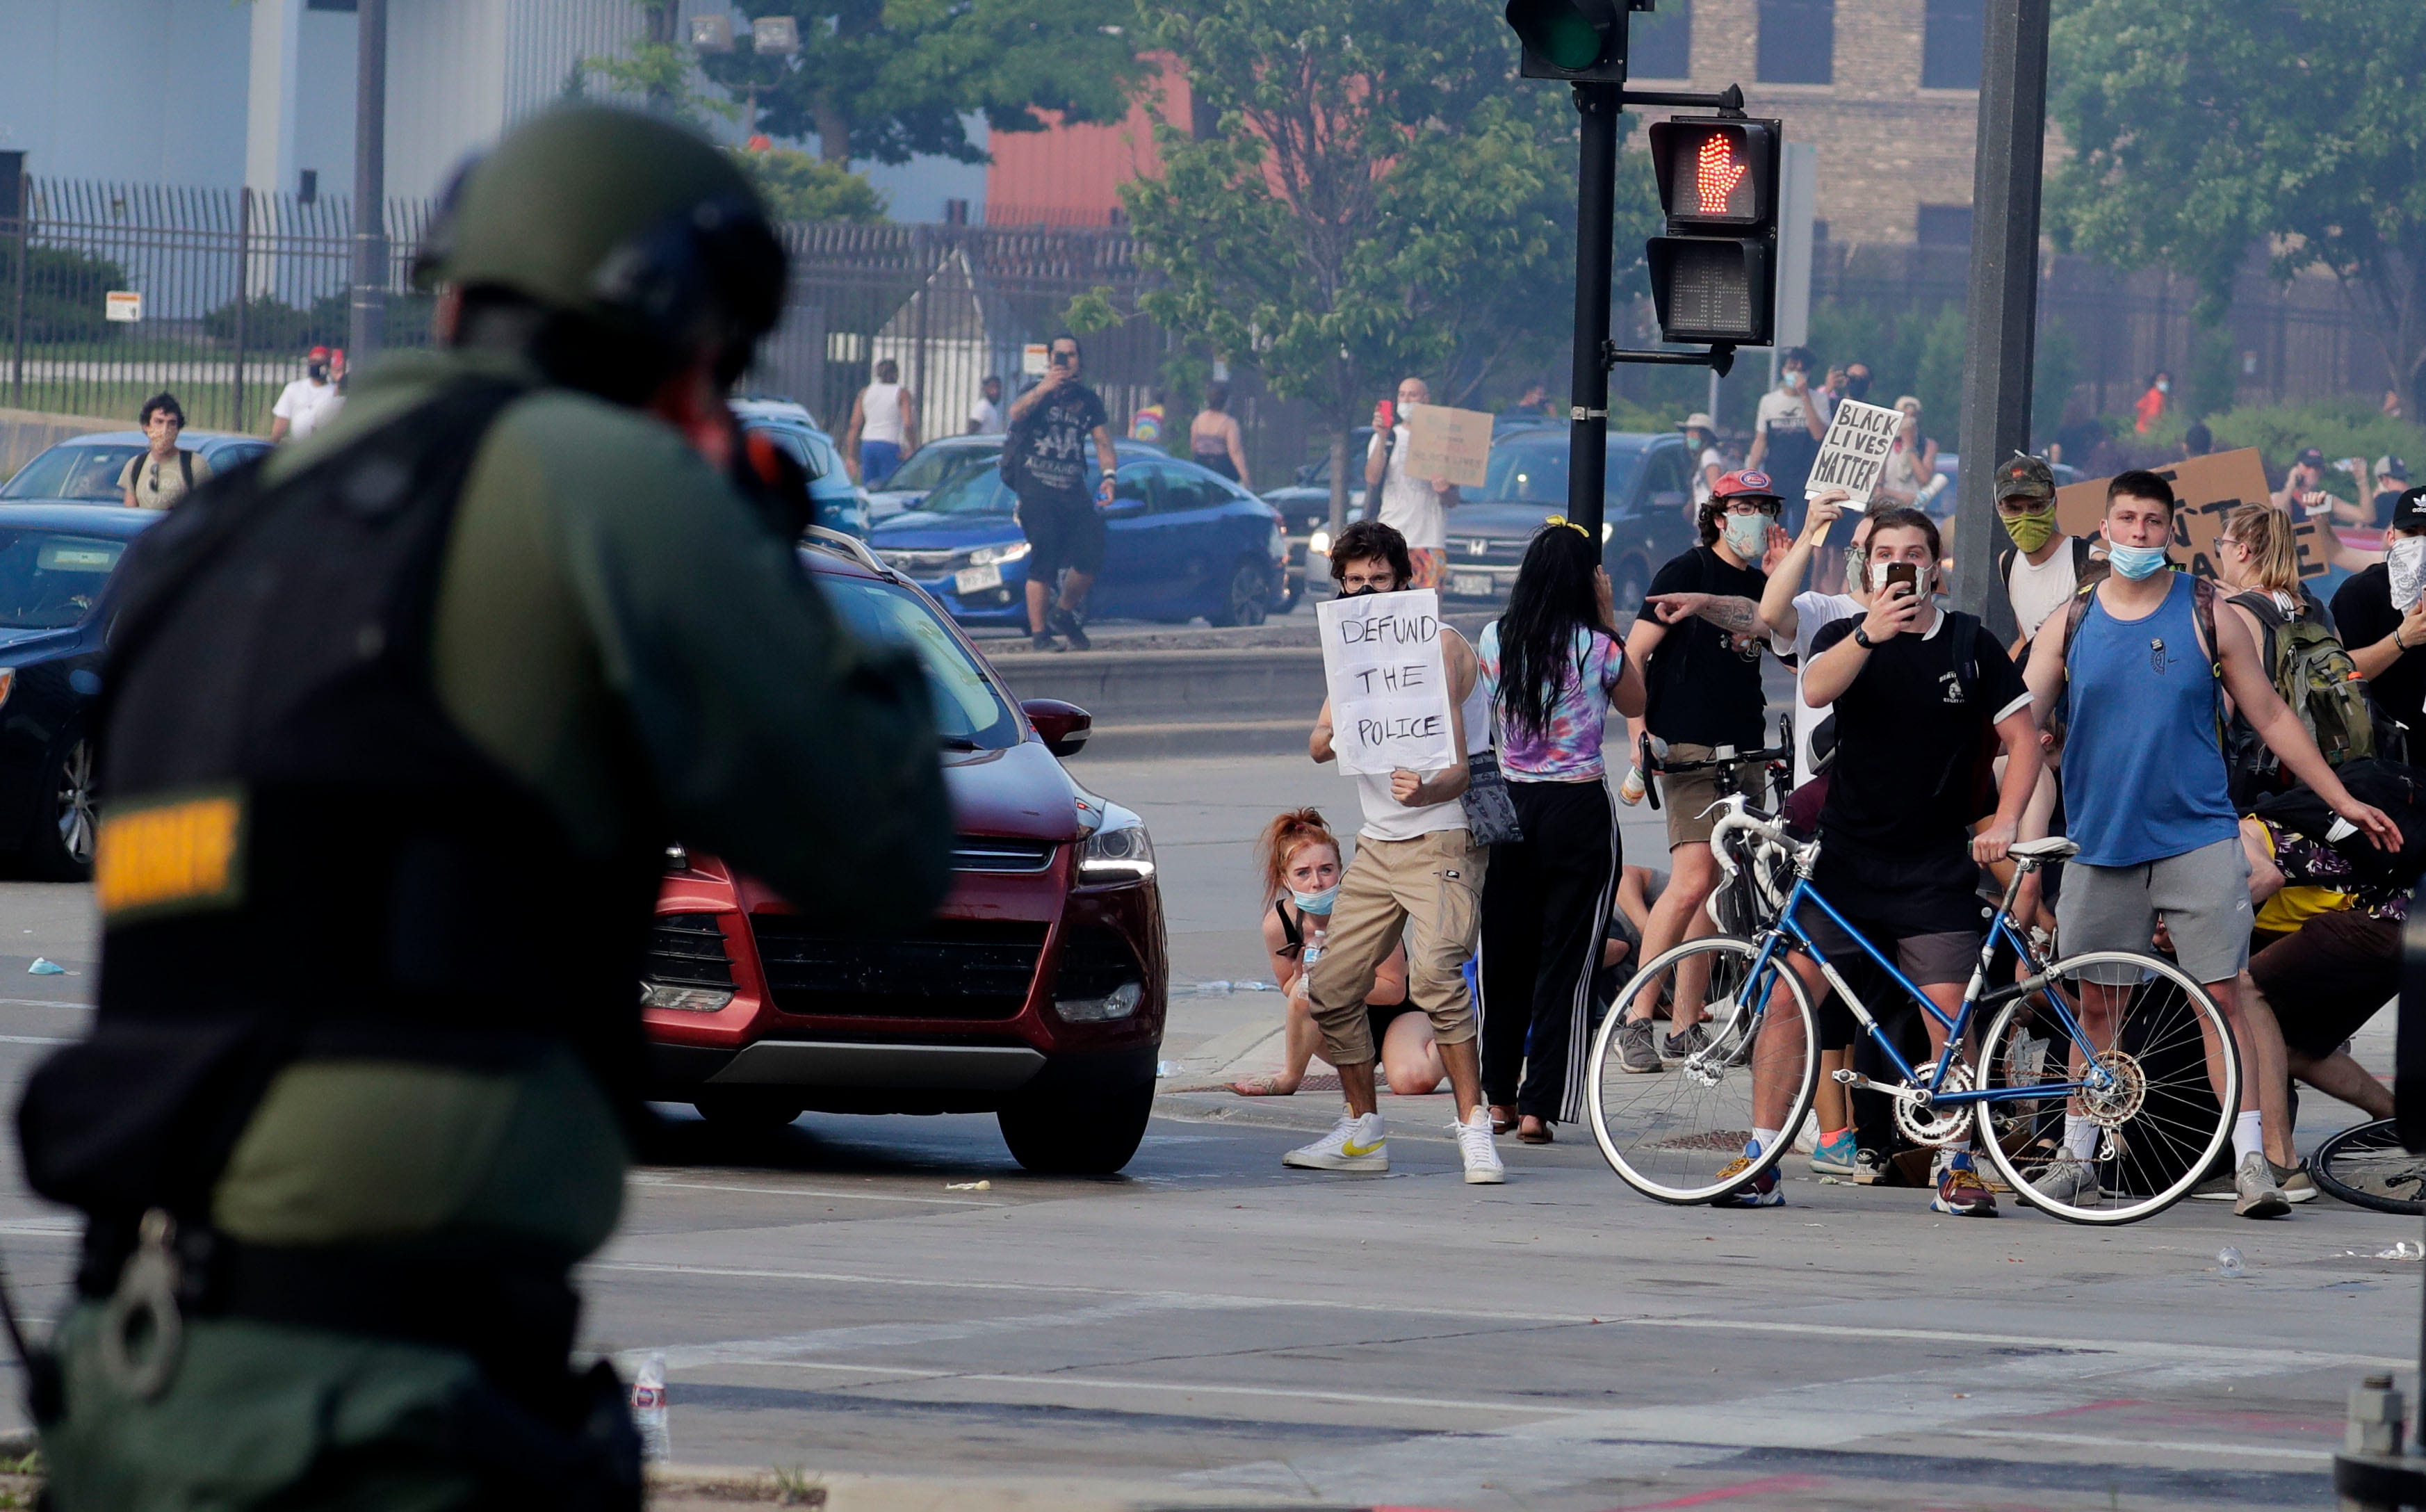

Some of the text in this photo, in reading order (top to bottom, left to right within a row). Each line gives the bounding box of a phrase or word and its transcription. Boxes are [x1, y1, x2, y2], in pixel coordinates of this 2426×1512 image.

[1837, 405, 1898, 436] BLACK
[1829, 427, 1889, 455] LIVES
[1814, 450, 1880, 492] MATTER
[1342, 615, 1438, 645] DEFUND
[1354, 665, 1428, 694] THE
[1358, 715, 1446, 749] POLICE
